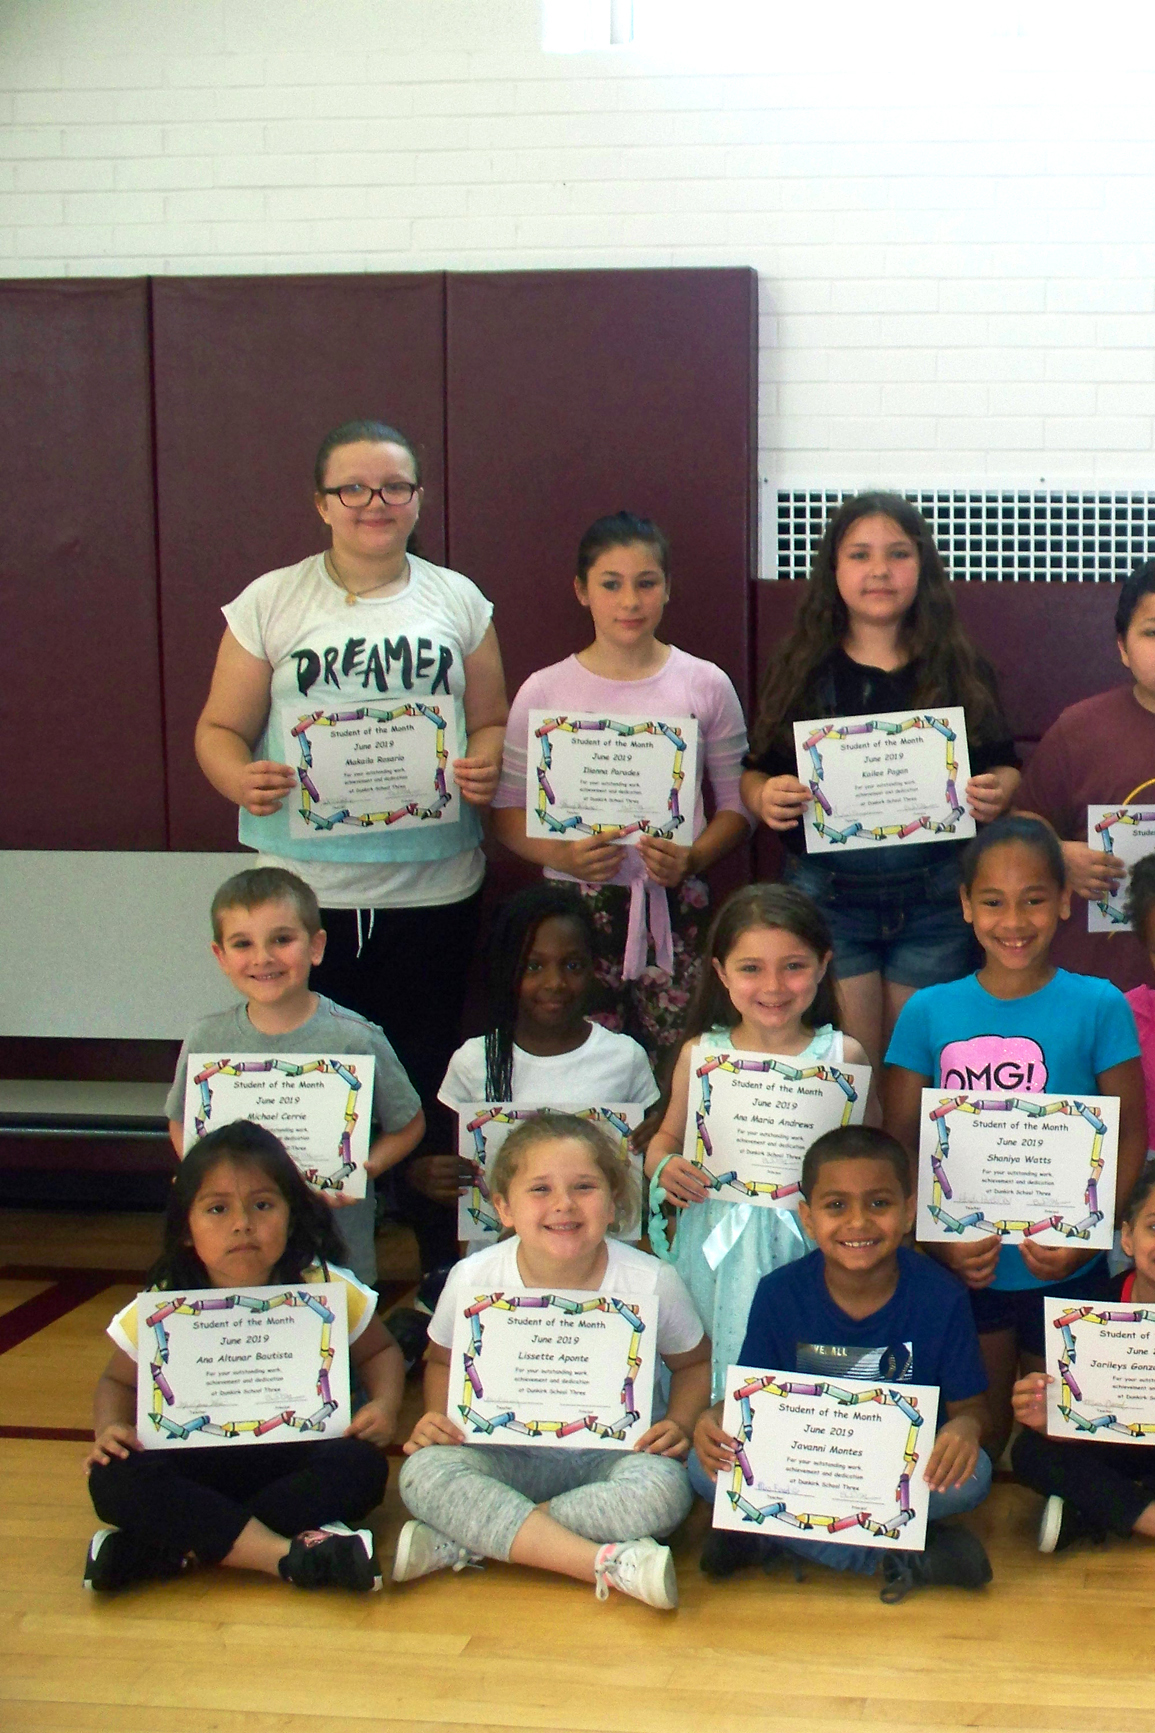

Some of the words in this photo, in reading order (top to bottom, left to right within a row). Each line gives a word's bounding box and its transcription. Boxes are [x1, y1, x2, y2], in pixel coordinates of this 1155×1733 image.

[291, 635, 453, 697] DREAMER
[330, 728, 360, 737] Student
[363, 726, 371, 735] of
[390, 724, 414, 732] Month
[353, 742, 371, 751] June
[374, 739, 394, 748] 2019
[571, 737, 600, 745] Student
[614, 739, 627, 747] the
[629, 740, 653, 748] Month
[840, 741, 870, 751] Student
[872, 739, 881, 747] of
[899, 735, 924, 744] Month
[591, 752, 609, 760] June
[612, 753, 632, 761] 2019
[863, 755, 881, 763] June
[884, 752, 904, 761] 2019
[886, 767, 908, 776] Pagan
[945, 1062, 1034, 1091] OMG!
[268, 1080, 278, 1088] of
[281, 1080, 295, 1088] the
[298, 1080, 324, 1088] Month
[731, 1078, 762, 1089] Student
[765, 1082, 775, 1091] of
[779, 1084, 793, 1093] the
[796, 1086, 823, 1096] Month
[255, 1096, 275, 1104] June
[278, 1096, 300, 1104] 2019
[751, 1097, 771, 1107] June
[775, 1100, 798, 1110] 2019
[733, 1113, 747, 1121] Ana
[750, 1114, 774, 1124] Maria
[778, 1118, 814, 1129] Andrews
[972, 1119, 1006, 1128] Student
[1009, 1120, 1019, 1129] of
[1023, 1121, 1038, 1130] the
[1041, 1122, 1068, 1131] Month
[996, 1137, 1017, 1146] June
[1020, 1138, 1043, 1147] 2019
[986, 1153, 1020, 1164] Shaniya
[1024, 1155, 1051, 1164] Watts
[192, 1320, 229, 1329] Student
[232, 1317, 242, 1327] of
[246, 1317, 262, 1326] the
[265, 1315, 294, 1325] Month
[506, 1316, 542, 1325] Student
[545, 1317, 555, 1326] of
[559, 1318, 574, 1327] the
[577, 1319, 606, 1328] Month
[219, 1336, 241, 1345] June
[245, 1334, 269, 1343] 2019
[530, 1334, 552, 1343] June
[556, 1335, 579, 1344] 2019
[1099, 1329, 1136, 1338] Student
[1140, 1331, 1150, 1339] of
[255, 1351, 292, 1360] Bautista
[1126, 1346, 1148, 1355] June
[517, 1351, 554, 1360] Lissette
[557, 1353, 588, 1363] Aponte
[778, 1402, 815, 1414] Student
[818, 1407, 829, 1416] of
[833, 1409, 848, 1418] the
[852, 1411, 881, 1422] Month
[803, 1423, 825, 1434] June
[829, 1426, 854, 1437] 2019
[828, 1445, 862, 1456] Montes
